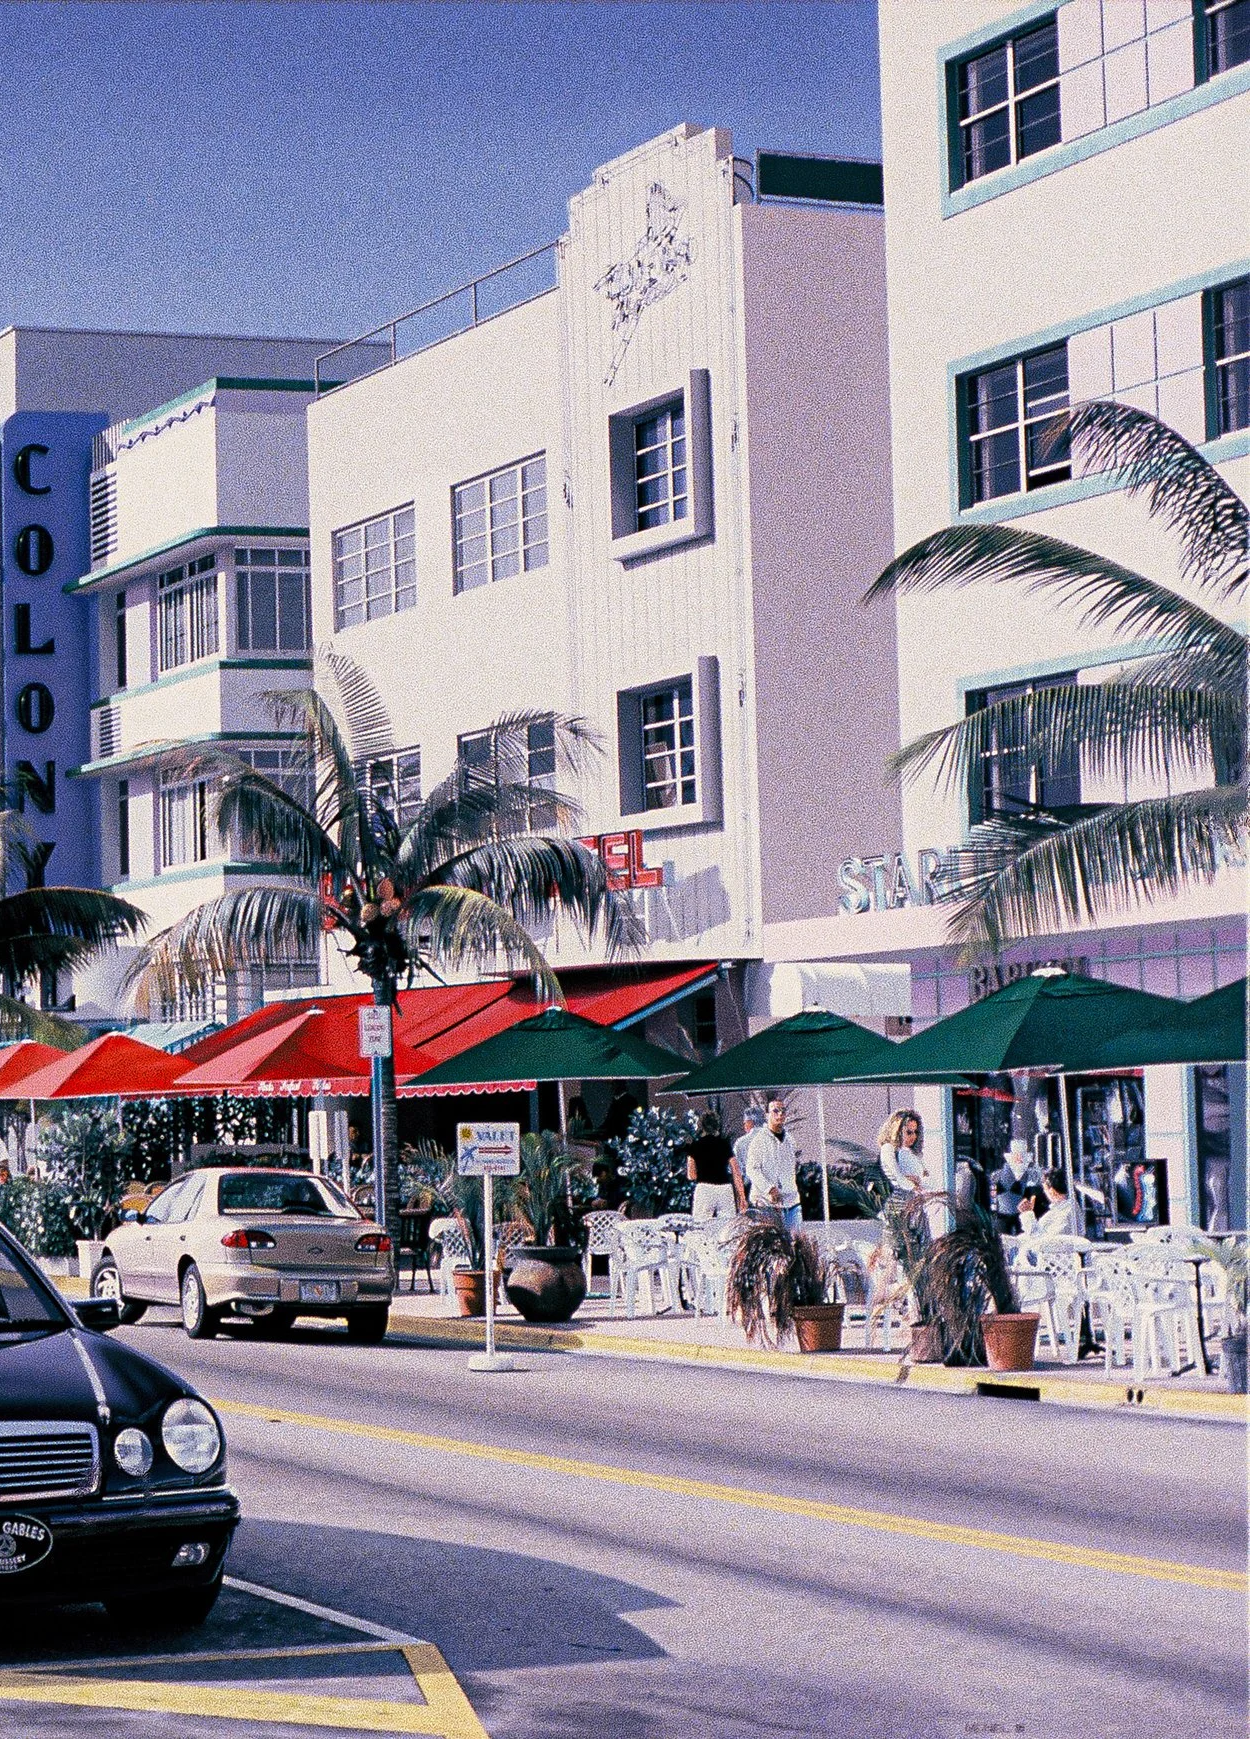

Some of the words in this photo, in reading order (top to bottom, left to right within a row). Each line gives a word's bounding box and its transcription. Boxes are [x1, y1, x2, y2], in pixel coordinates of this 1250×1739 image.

[13, 443, 57, 891] COLONY
[837, 847, 948, 915] STAR
[476, 1130, 515, 1142] VALET
[2, 1521, 46, 1542] GABLES
